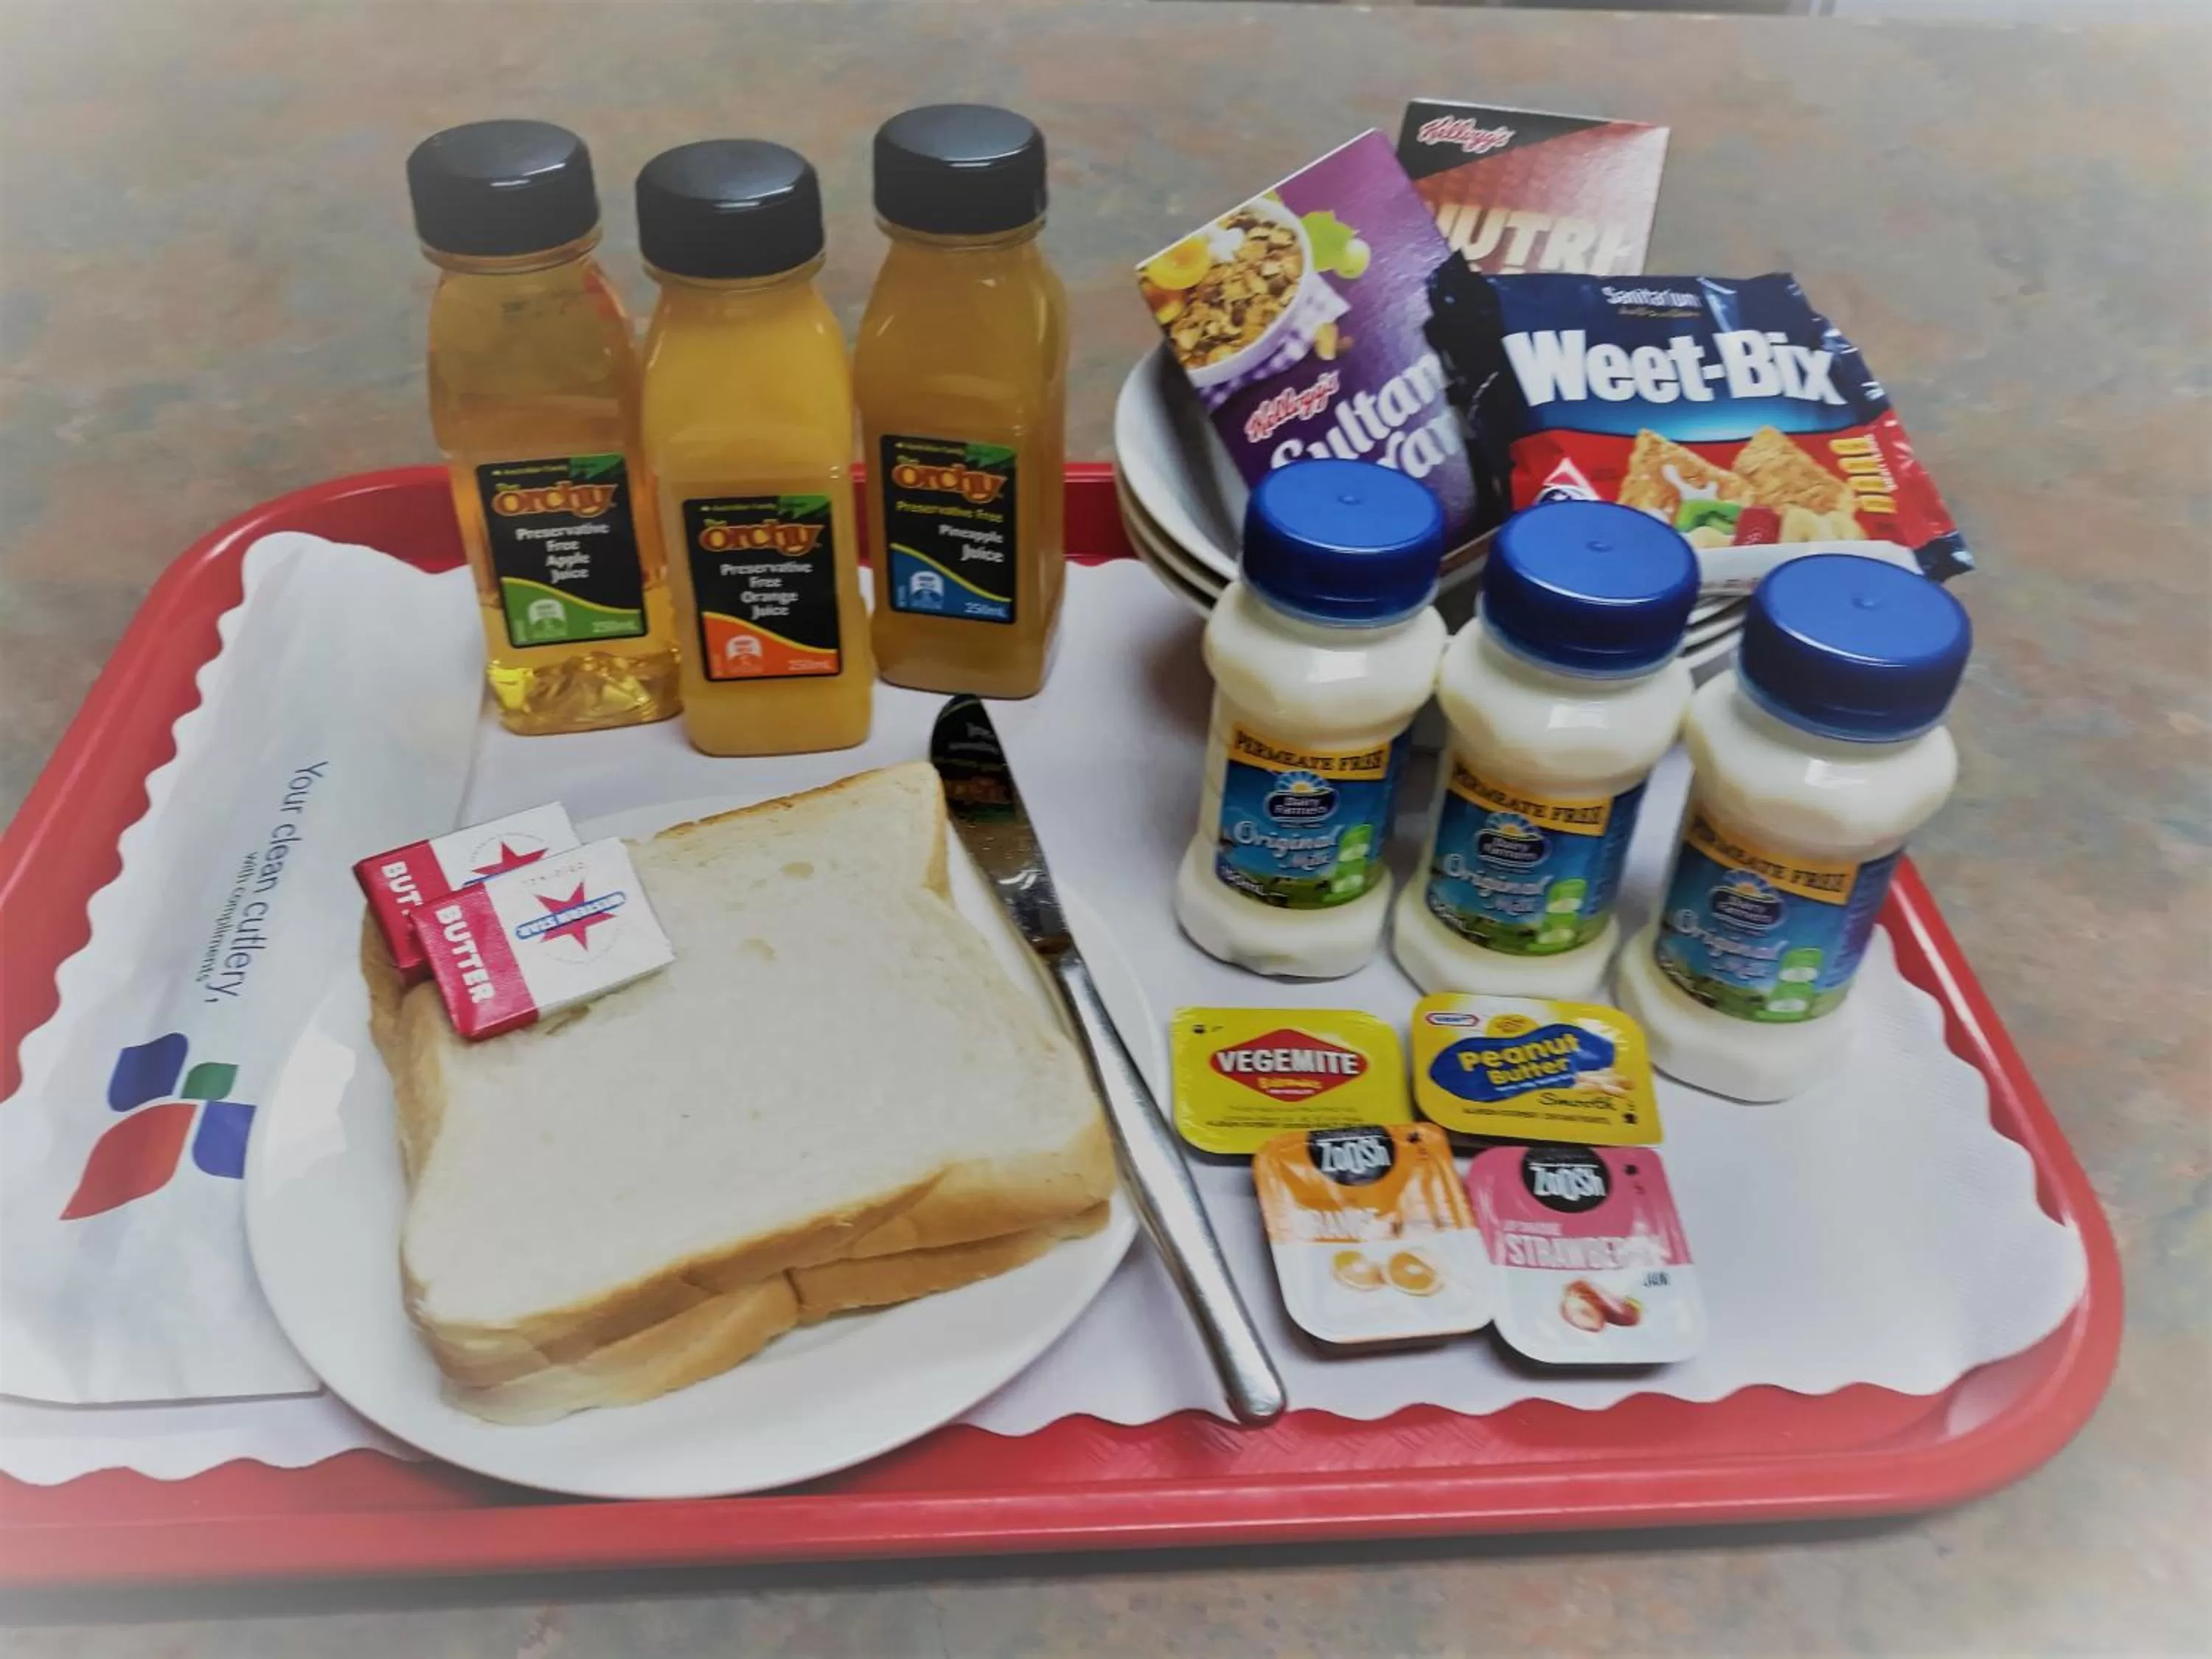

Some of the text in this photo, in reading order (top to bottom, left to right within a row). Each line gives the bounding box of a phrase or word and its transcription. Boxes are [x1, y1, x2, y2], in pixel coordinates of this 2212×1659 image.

[1416, 114, 1517, 153] Kellogg's
[1601, 285, 1703, 307] Sanitarium
[1501, 329, 1848, 407] Weet-Bix
[1242, 369, 1340, 443] Kellogg's
[891, 464, 1008, 504] Orchy
[492, 480, 618, 518] Orchy
[515, 522, 611, 540] Preservative
[699, 519, 825, 557] Orchy
[938, 524, 1004, 544] Pineapple
[546, 540, 581, 552] Free
[961, 543, 1005, 563] Juice
[545, 552, 590, 570] Apple
[720, 561, 813, 577] Preservative
[550, 568, 589, 584] Juice
[748, 576, 783, 588] Free
[740, 591, 799, 605] Orange
[751, 605, 790, 620] Juice
[1233, 820, 1346, 858] Original
[204, 761, 329, 1004] Your clean cutlery,
[380, 860, 425, 917] BUT
[1443, 853, 1555, 897] Original
[435, 905, 497, 1004] BUTTER
[1217, 1048, 1360, 1075] VEGEMITE
[1457, 1032, 1581, 1074] Peanut
[1486, 1057, 1572, 1086] Butter
[1537, 1091, 1616, 1112] Smooth
